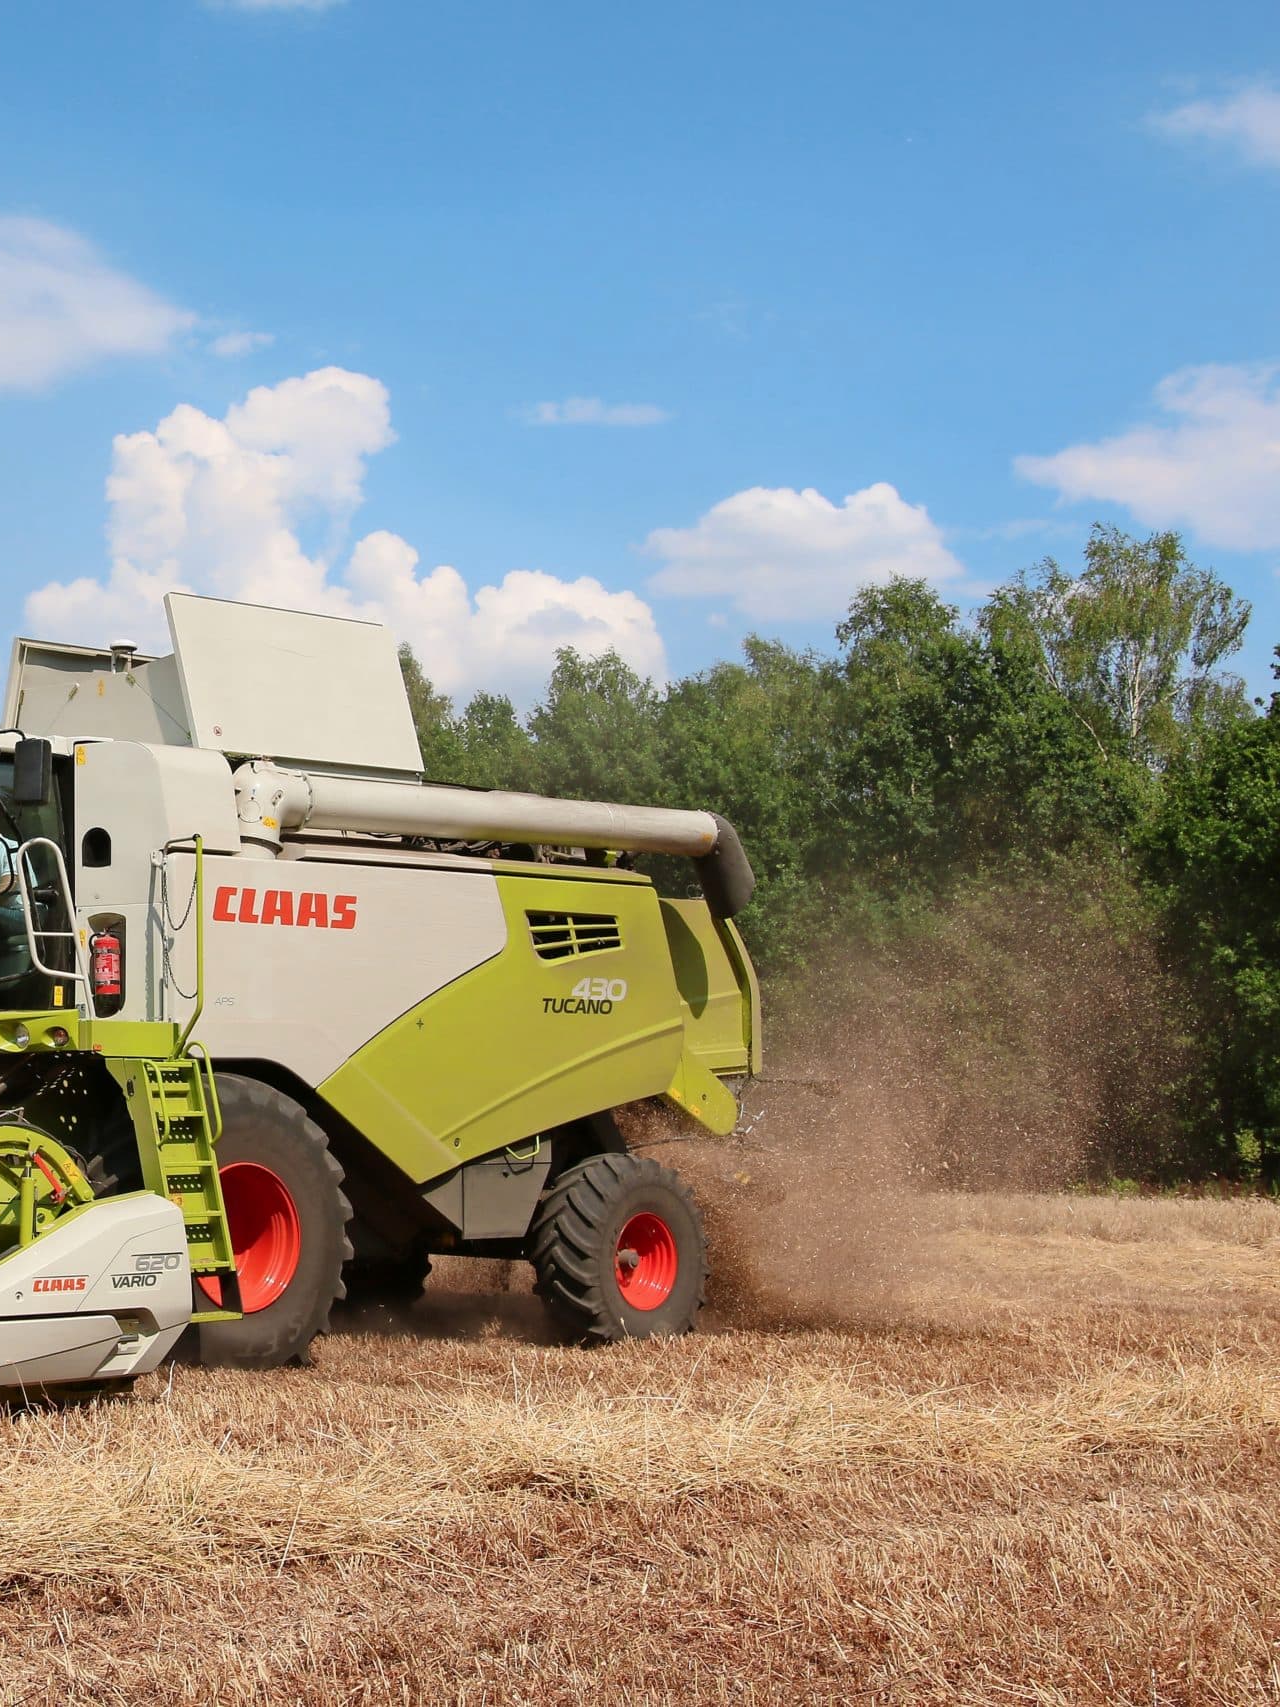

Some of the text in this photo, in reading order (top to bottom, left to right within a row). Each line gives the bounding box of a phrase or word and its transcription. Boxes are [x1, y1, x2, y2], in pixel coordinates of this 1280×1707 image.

[212, 886, 358, 930] CLAAS
[571, 977, 627, 1002] 430
[542, 998, 613, 1015] TUCANO
[135, 1256, 180, 1272] 620
[33, 1278, 86, 1292] CLAAS
[111, 1275, 157, 1289] VARIO
